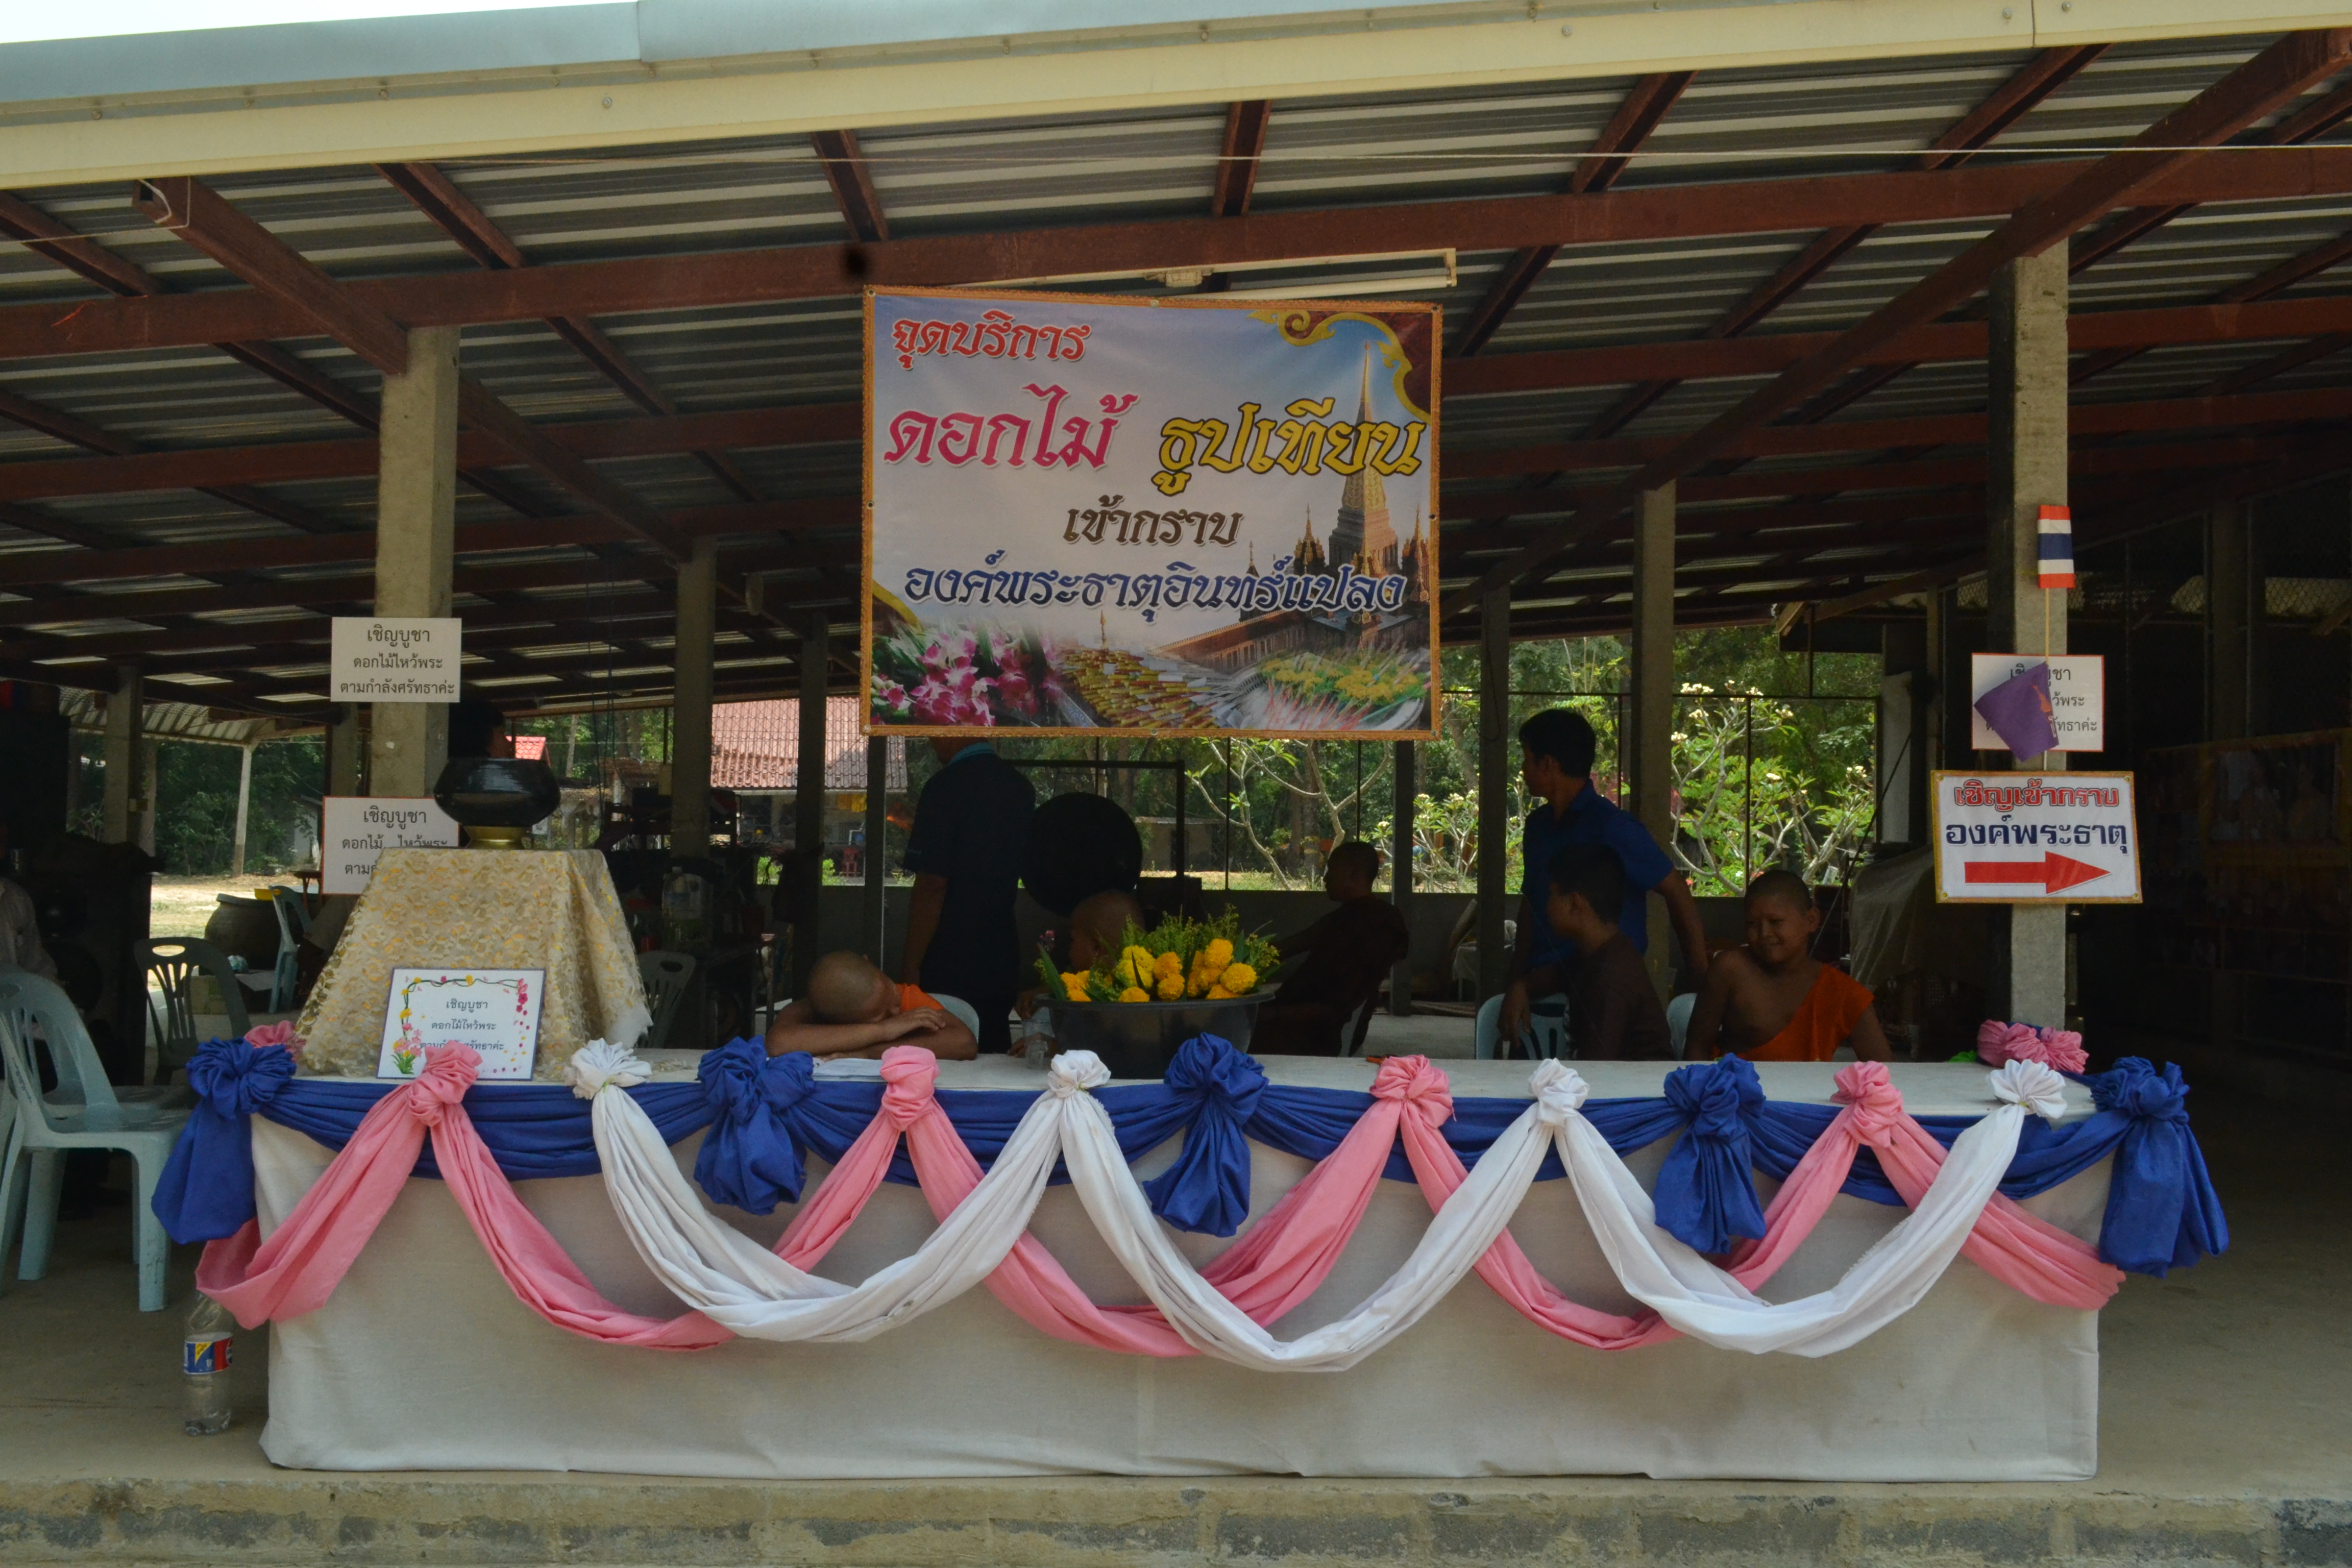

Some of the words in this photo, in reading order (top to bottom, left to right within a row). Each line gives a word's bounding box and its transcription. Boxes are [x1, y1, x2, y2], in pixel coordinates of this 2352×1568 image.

[892, 309, 1091, 370] จุดบริการ
[883, 383, 1138, 470] ดอกไม้
[1151, 397, 1426, 496] ธูปเทียน
[1062, 495, 1245, 546] เข้ากราบ
[904, 550, 1408, 624] องค์พระธาตุอินทร์แปลง
[368, 624, 430, 648] เชิญบูชา
[354, 653, 443, 669] ดอกไม้ไหว้พระ
[340, 678, 454, 694] ตามกำลังศรัทธาค่ะ
[1953, 778, 2119, 812] เชิญเข้ากราบ
[364, 805, 427, 829] เชิญบูชา
[342, 834, 384, 849] ดอกไม้
[1945, 814, 2128, 854] องค์พระธาตุ
[446, 998, 488, 1013] เชิญบูชา
[431, 1018, 496, 1030] ดอกไม้ไหว้พระ
